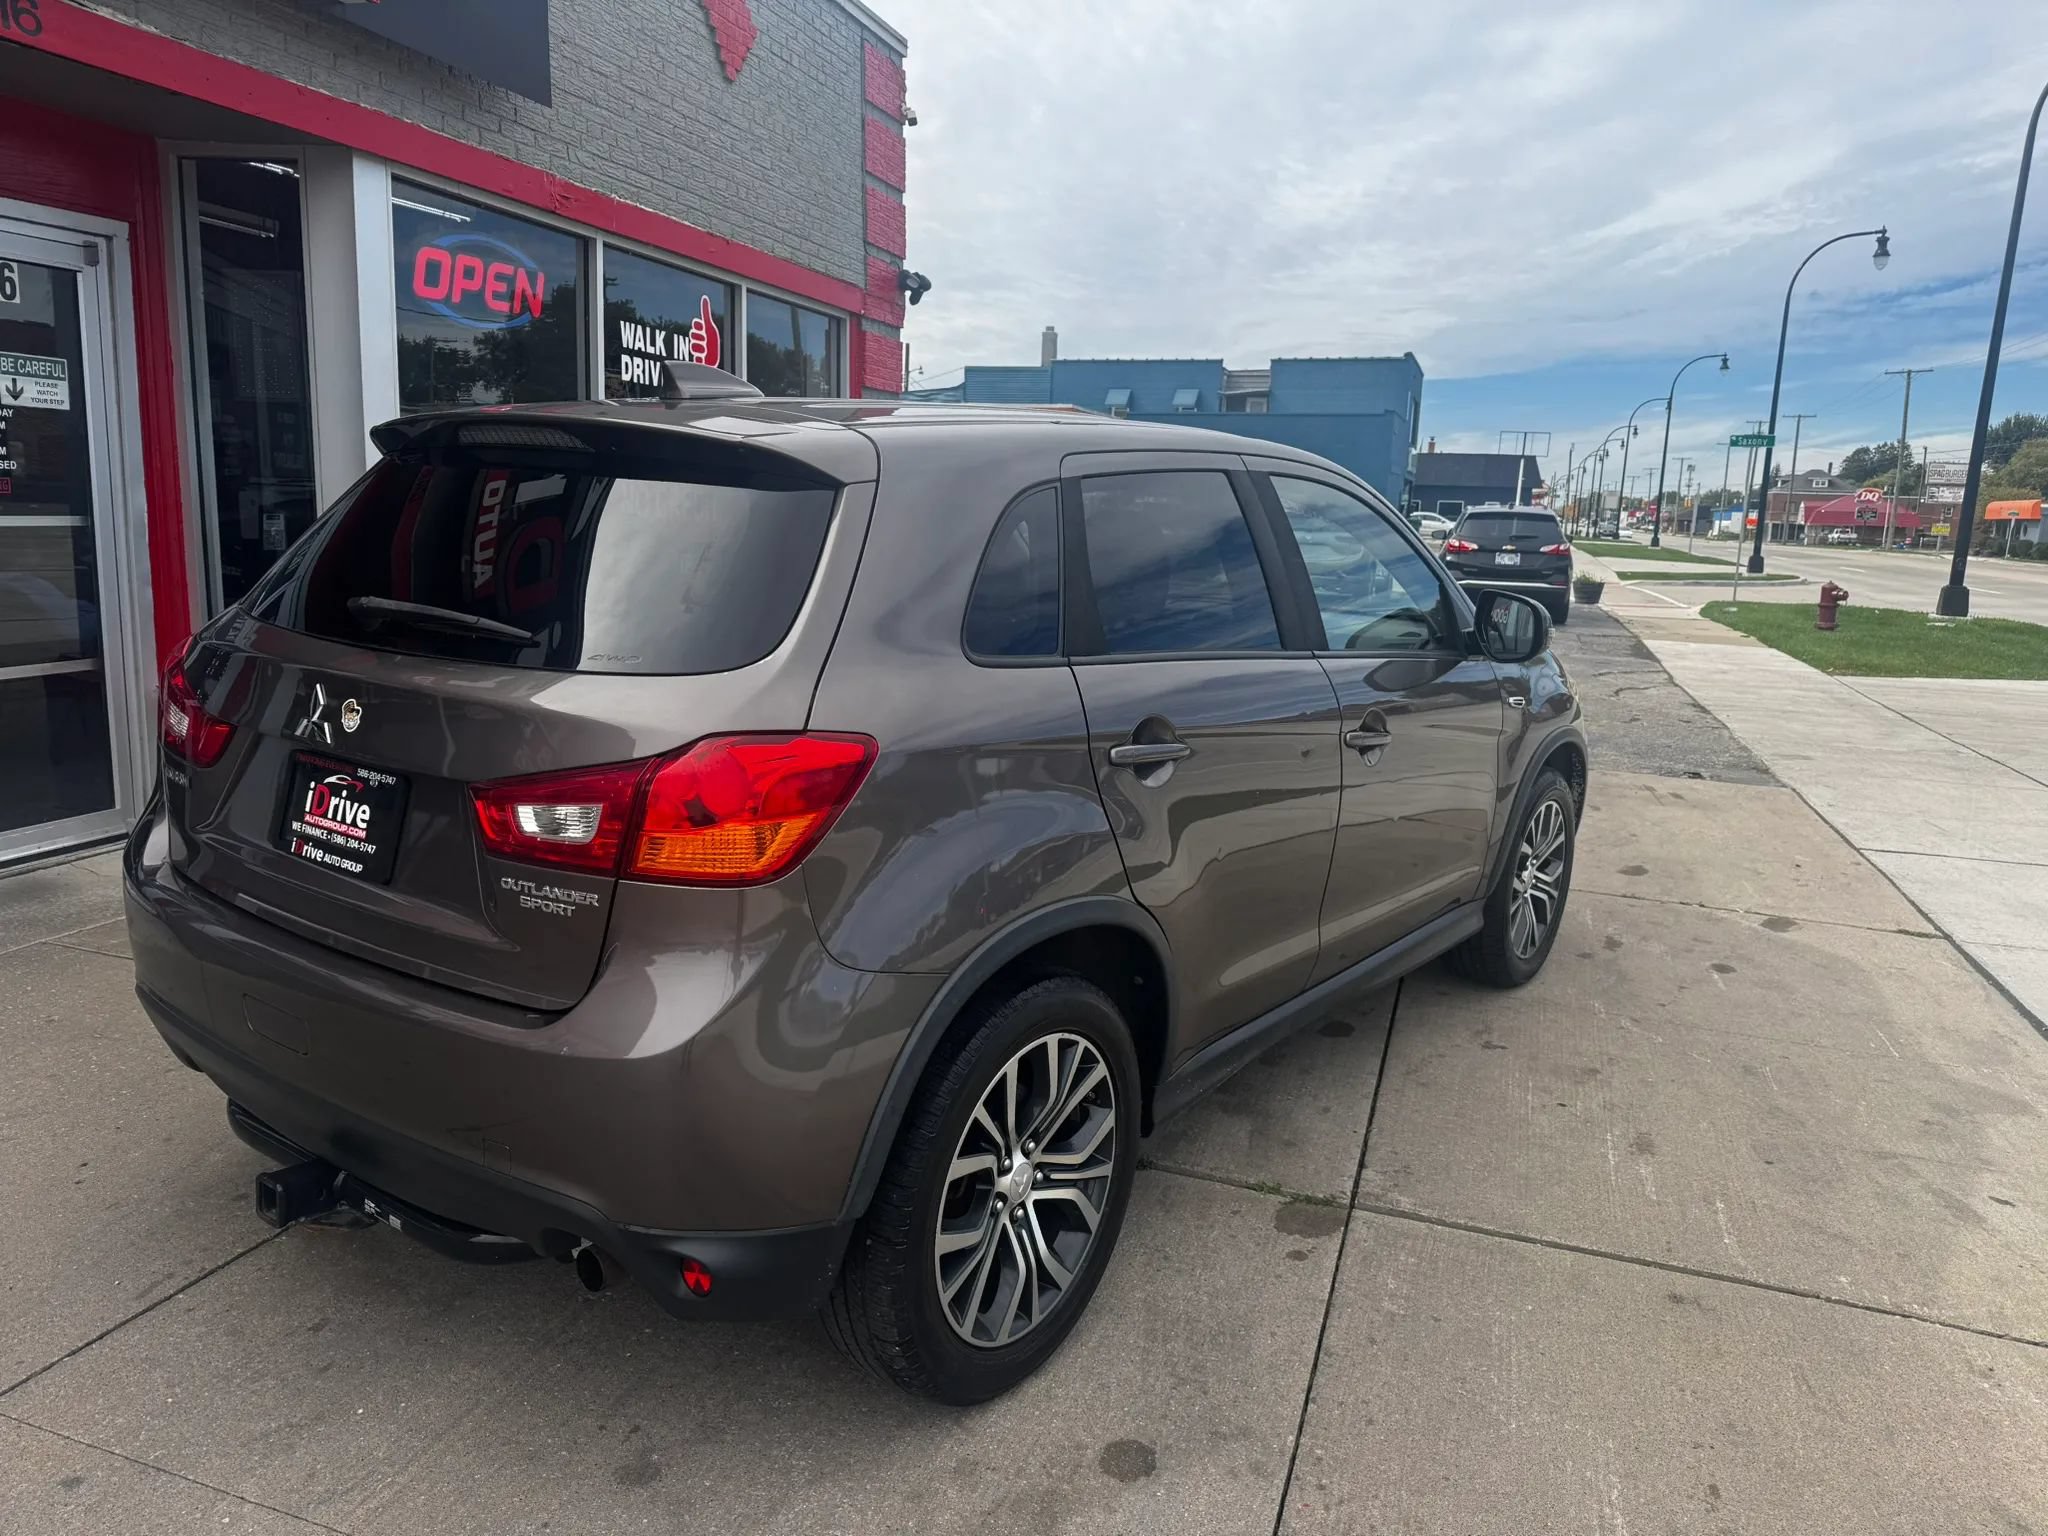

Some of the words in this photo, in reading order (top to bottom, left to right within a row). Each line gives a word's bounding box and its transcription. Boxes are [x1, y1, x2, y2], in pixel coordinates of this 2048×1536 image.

[413, 246, 545, 318] OPEN
[620, 320, 667, 357] WALK
[673, 333, 690, 362] IN
[1, 357, 15, 372] BE
[18, 360, 65, 378] CAREFUL
[621, 354, 664, 387] DRIV
[35, 381, 58, 389] PLEASE
[31, 397, 49, 405] YOUR
[1738, 437, 1768, 446] Saxony
[1860, 491, 1880, 502] DQ
[357, 768, 396, 785] 586-204-5747
[304, 781, 370, 828] iDrive
[292, 820, 302, 832] WE
[301, 823, 328, 840] FINANCE
[347, 838, 376, 854] 204-5747
[304, 813, 367, 839] AUTOGROUP.COM
[291, 838, 323, 861] iDrive
[323, 855, 341, 866] AUTO
[341, 858, 363, 873] GROUP
[500, 878, 599, 906] OUTLANDER
[520, 895, 575, 917] SPORT
